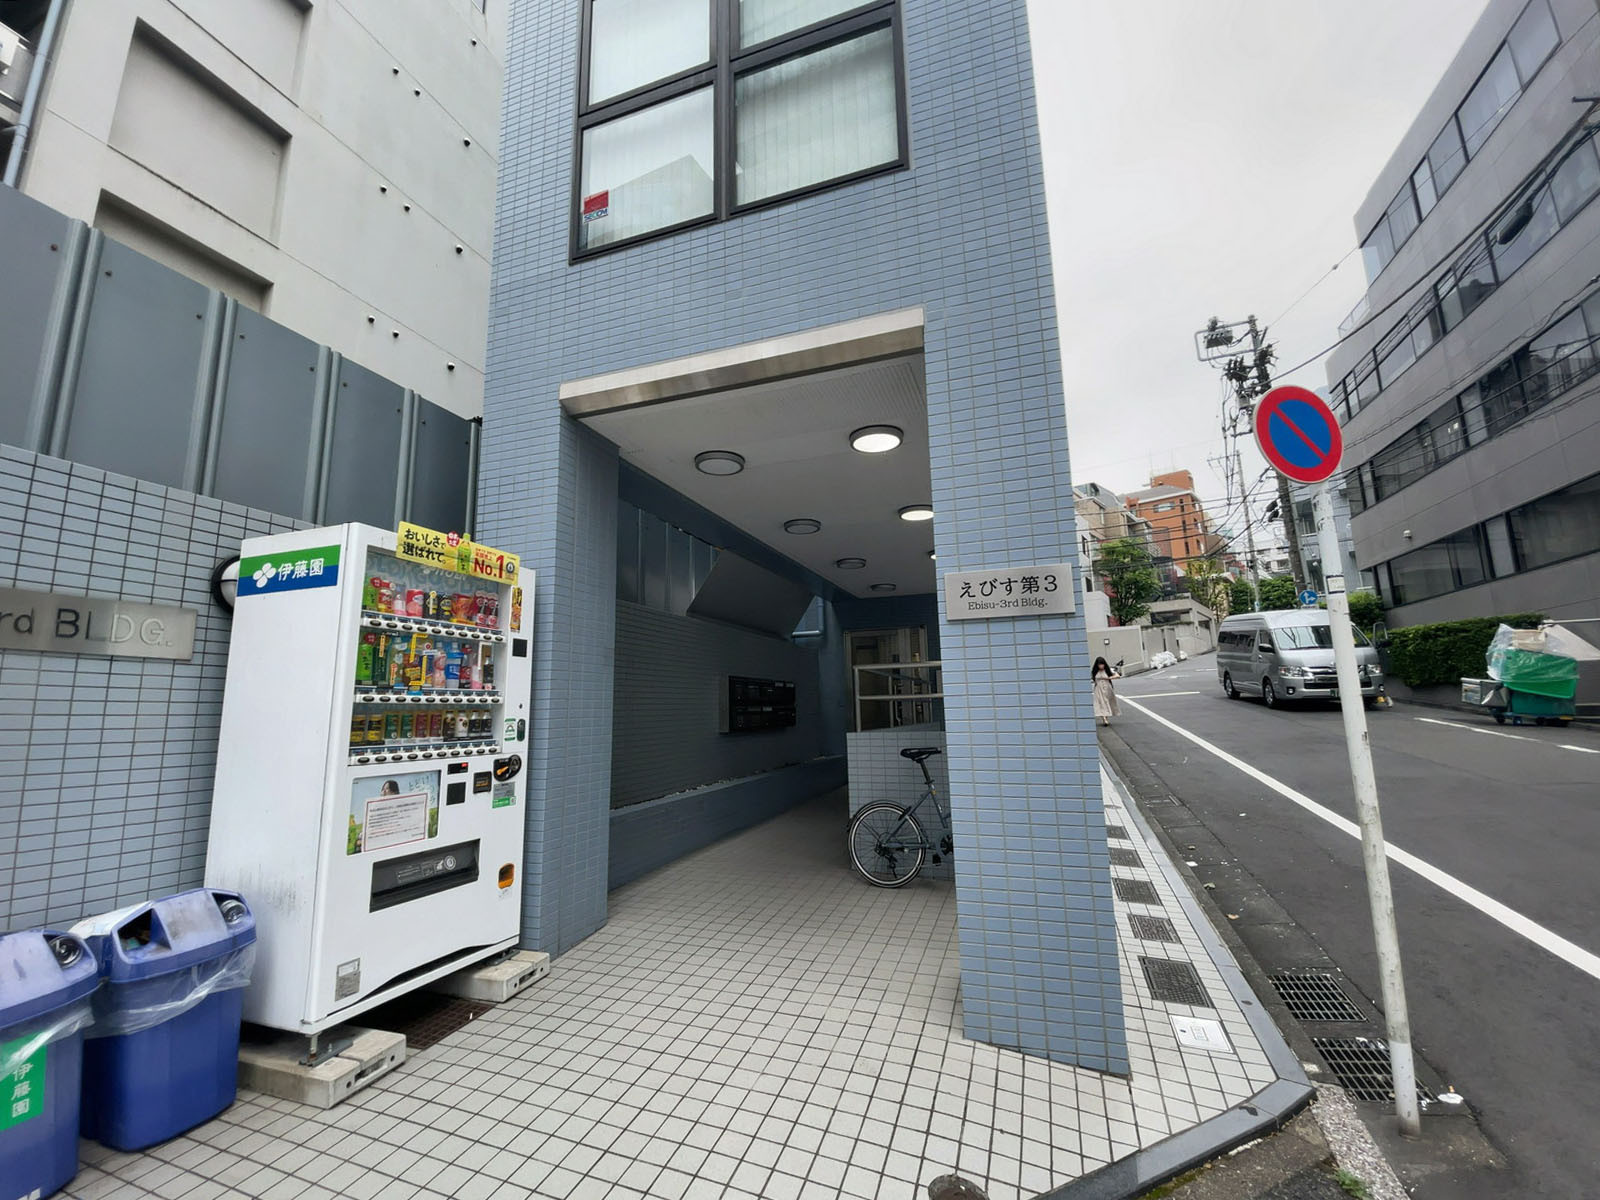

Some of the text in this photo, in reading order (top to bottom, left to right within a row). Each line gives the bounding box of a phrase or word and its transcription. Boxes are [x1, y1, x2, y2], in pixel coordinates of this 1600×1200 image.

[404, 528, 446, 549] おいしさで
[402, 541, 446, 565] 選ばれて。
[278, 558, 324, 581] 伊藤園
[474, 555, 505, 579] No.1
[960, 574, 1058, 598] えびす第3
[968, 598, 1048, 610] Ebisu-3rd Bldg.
[55, 608, 174, 647] BLDG.
[11, 1062, 33, 1118] 伊藤園
